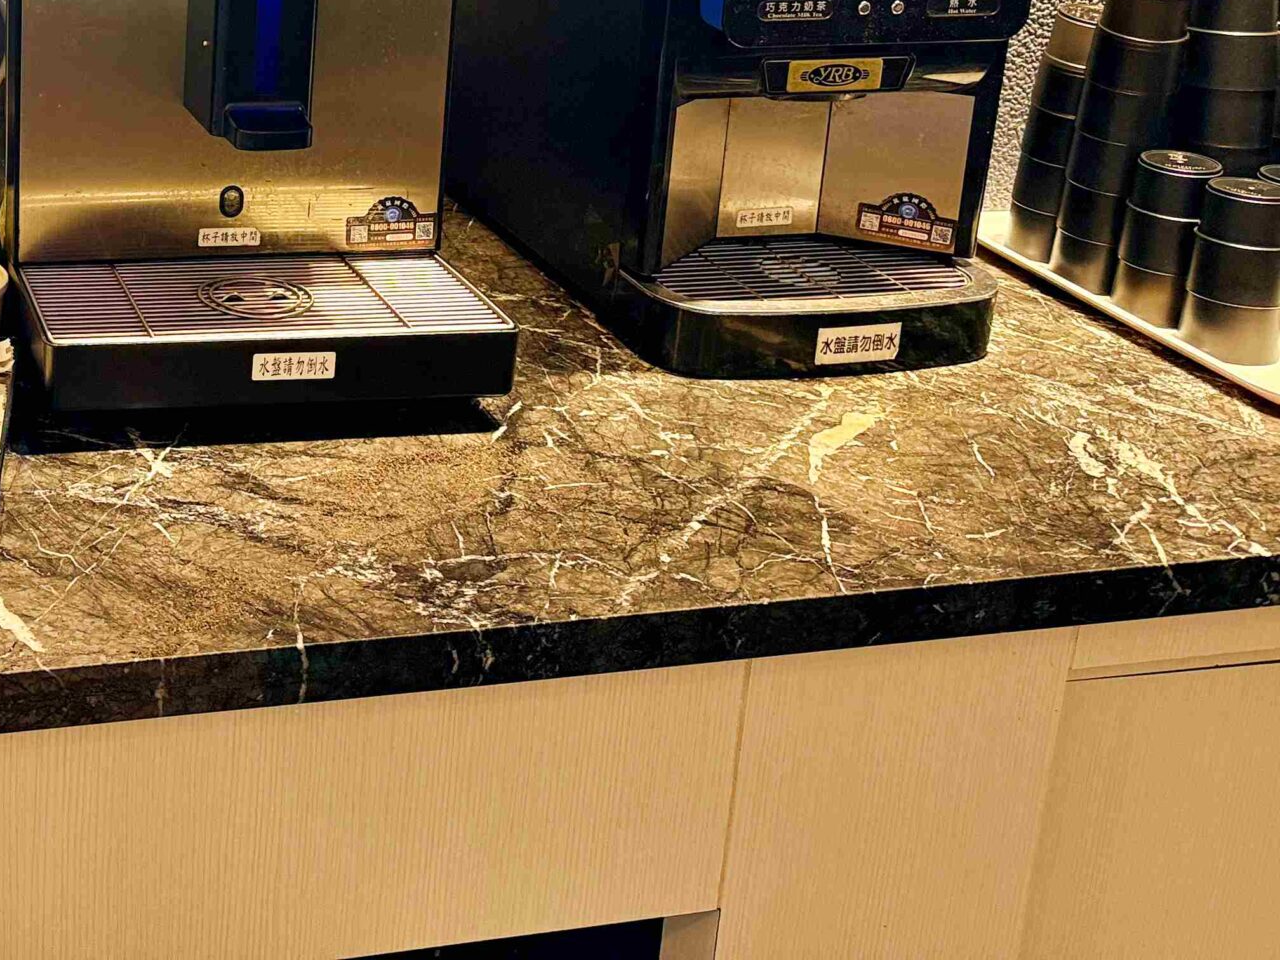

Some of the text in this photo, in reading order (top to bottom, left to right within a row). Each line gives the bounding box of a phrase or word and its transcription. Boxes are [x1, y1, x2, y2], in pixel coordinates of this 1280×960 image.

[765, 1, 827, 13] 巧克力奶茶
[201, 230, 258, 244] 杯子請放中間
[820, 332, 898, 355] 水盤請勿倒水
[259, 355, 330, 377] 水盤請勿倒水
